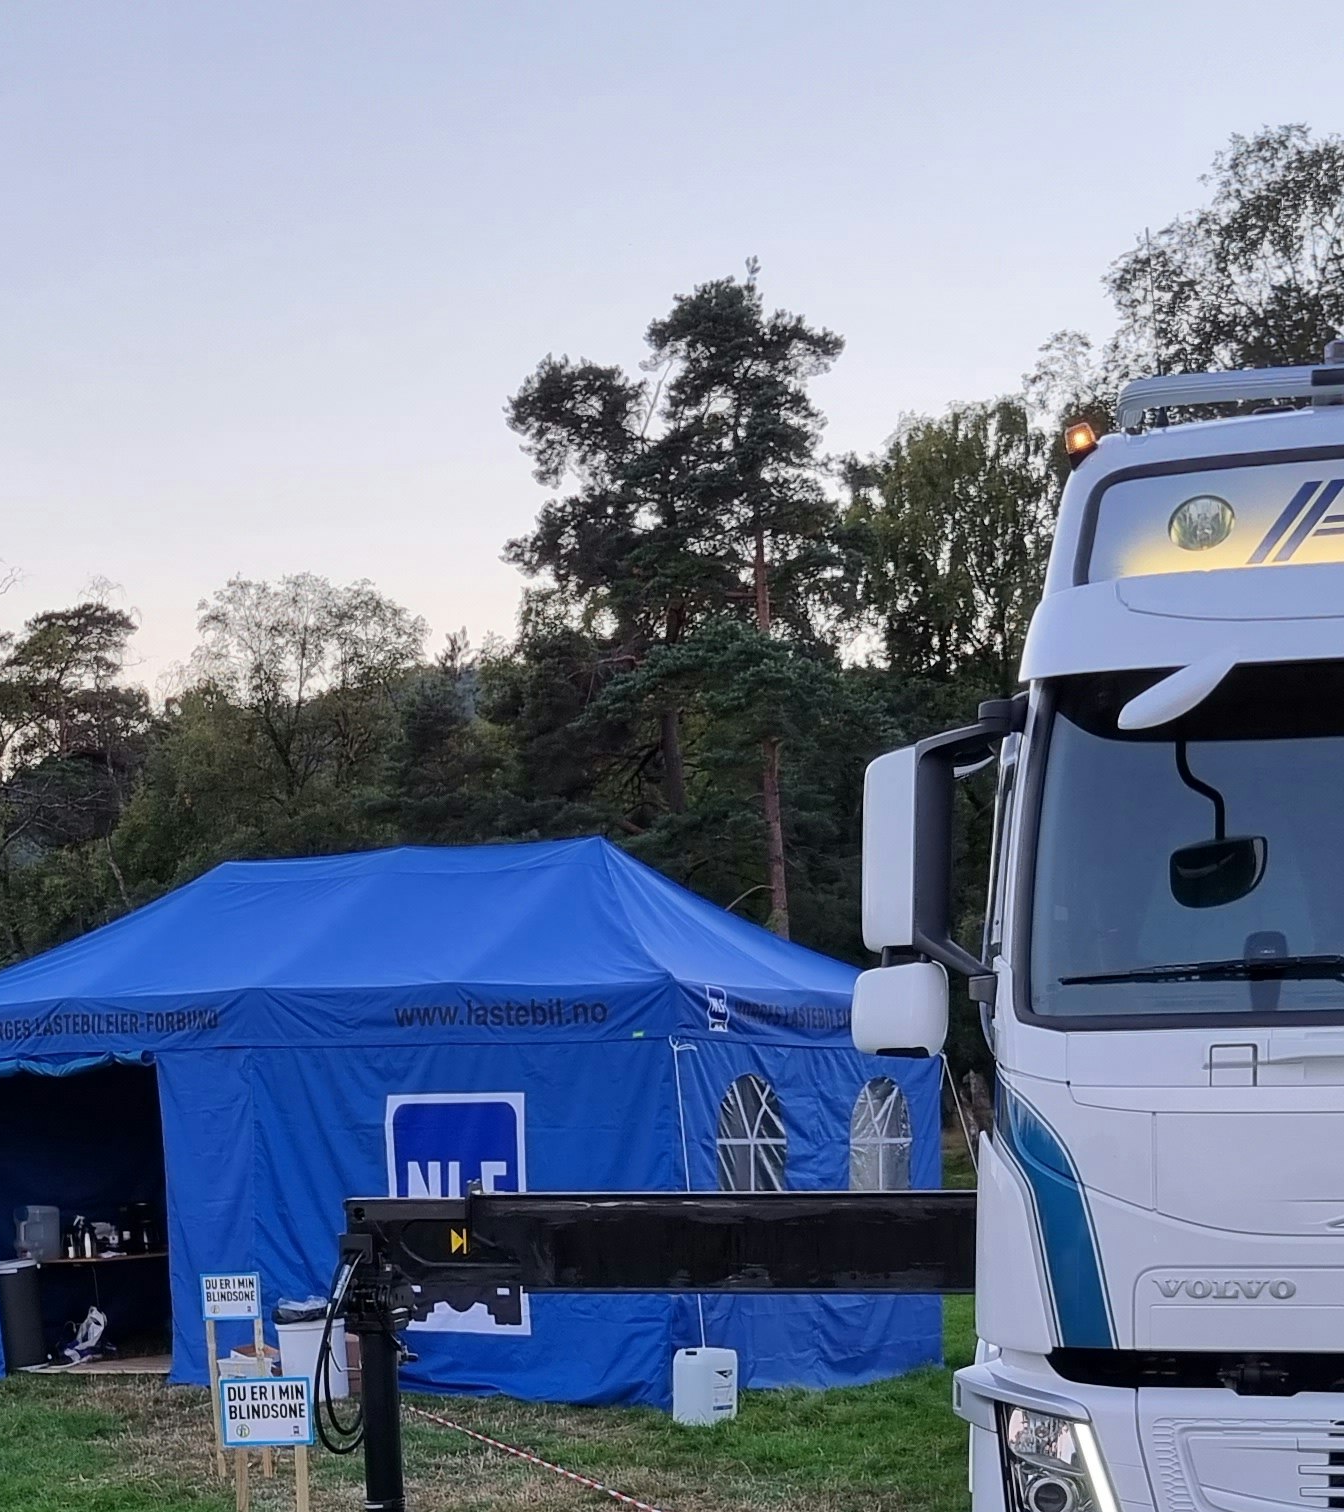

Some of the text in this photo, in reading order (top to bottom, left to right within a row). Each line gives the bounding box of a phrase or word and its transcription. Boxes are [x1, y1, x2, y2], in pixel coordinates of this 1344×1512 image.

[395, 998, 607, 1027] www.lastebil.no
[205, 1279, 218, 1289] DU
[220, 1278, 231, 1289] ER
[238, 1278, 254, 1288] MIN
[1152, 1279, 1296, 1300] VOLVO
[206, 1290, 255, 1302] BLINDSONE
[228, 1384, 304, 1402] DU ER I MIN
[229, 1403, 306, 1420] BLINDSONE
